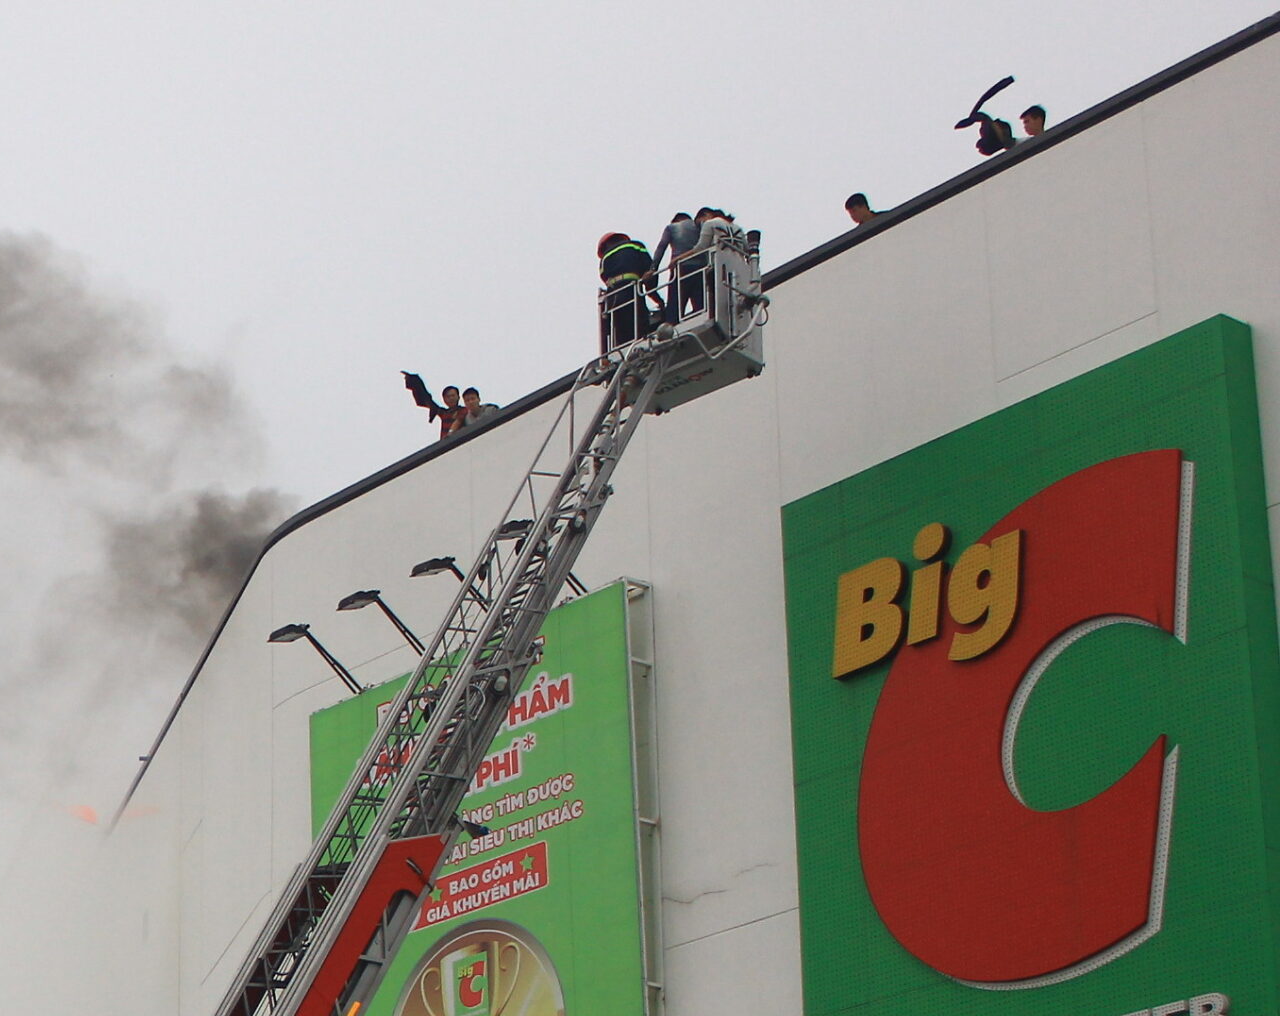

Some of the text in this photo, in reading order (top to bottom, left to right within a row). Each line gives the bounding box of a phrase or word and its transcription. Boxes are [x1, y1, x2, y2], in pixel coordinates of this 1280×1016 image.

[832, 521, 1022, 680] Big
[507, 675, 570, 727] HẨM
[857, 449, 1194, 990] C
[495, 793, 524, 817] TÌM
[526, 774, 575, 805] ĐƯỢC
[445, 841, 467, 866] ẠI
[508, 817, 535, 841] THỊ
[537, 800, 584, 832] KHÁC
[426, 901, 451, 923] GIÁ
[453, 881, 510, 915] KHUYẾN
[448, 874, 479, 896] BAO
